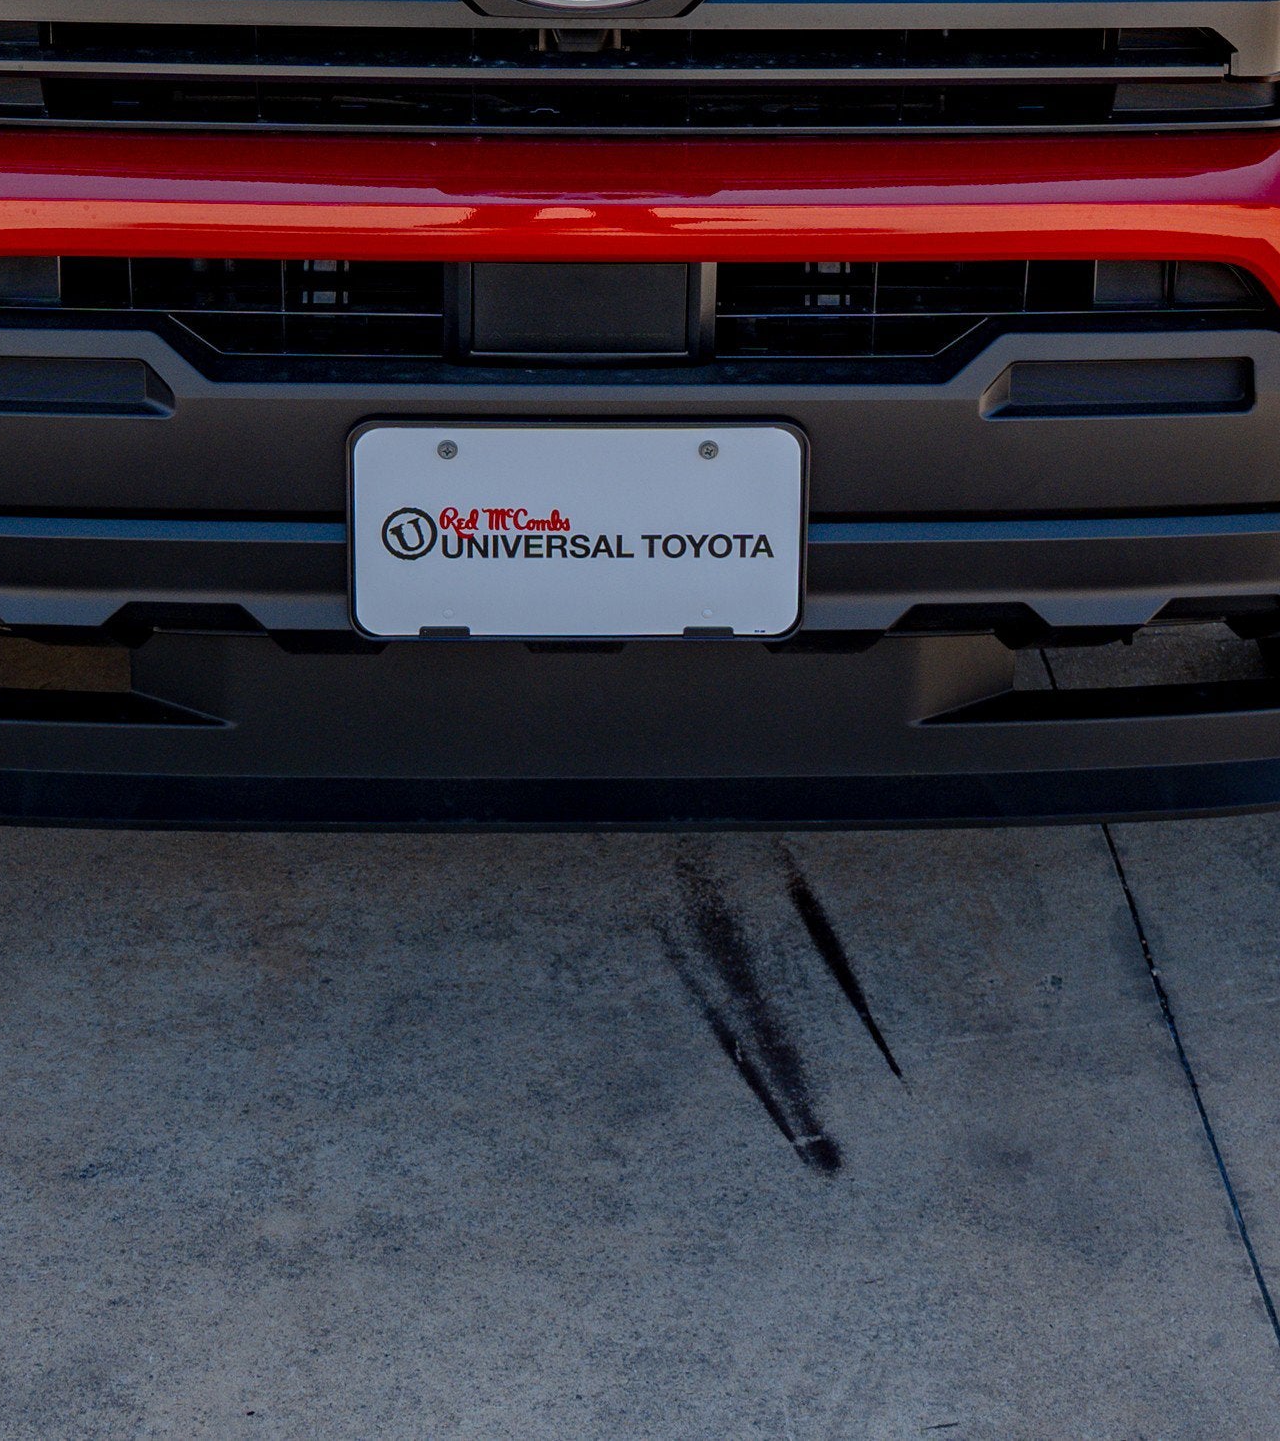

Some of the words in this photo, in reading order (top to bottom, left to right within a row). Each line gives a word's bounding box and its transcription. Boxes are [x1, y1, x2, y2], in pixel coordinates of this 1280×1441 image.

[440, 507, 479, 540] Red
[482, 508, 570, 532] McCombs
[442, 534, 635, 559] UNIVERSAL
[641, 534, 774, 559] TOYOTA
